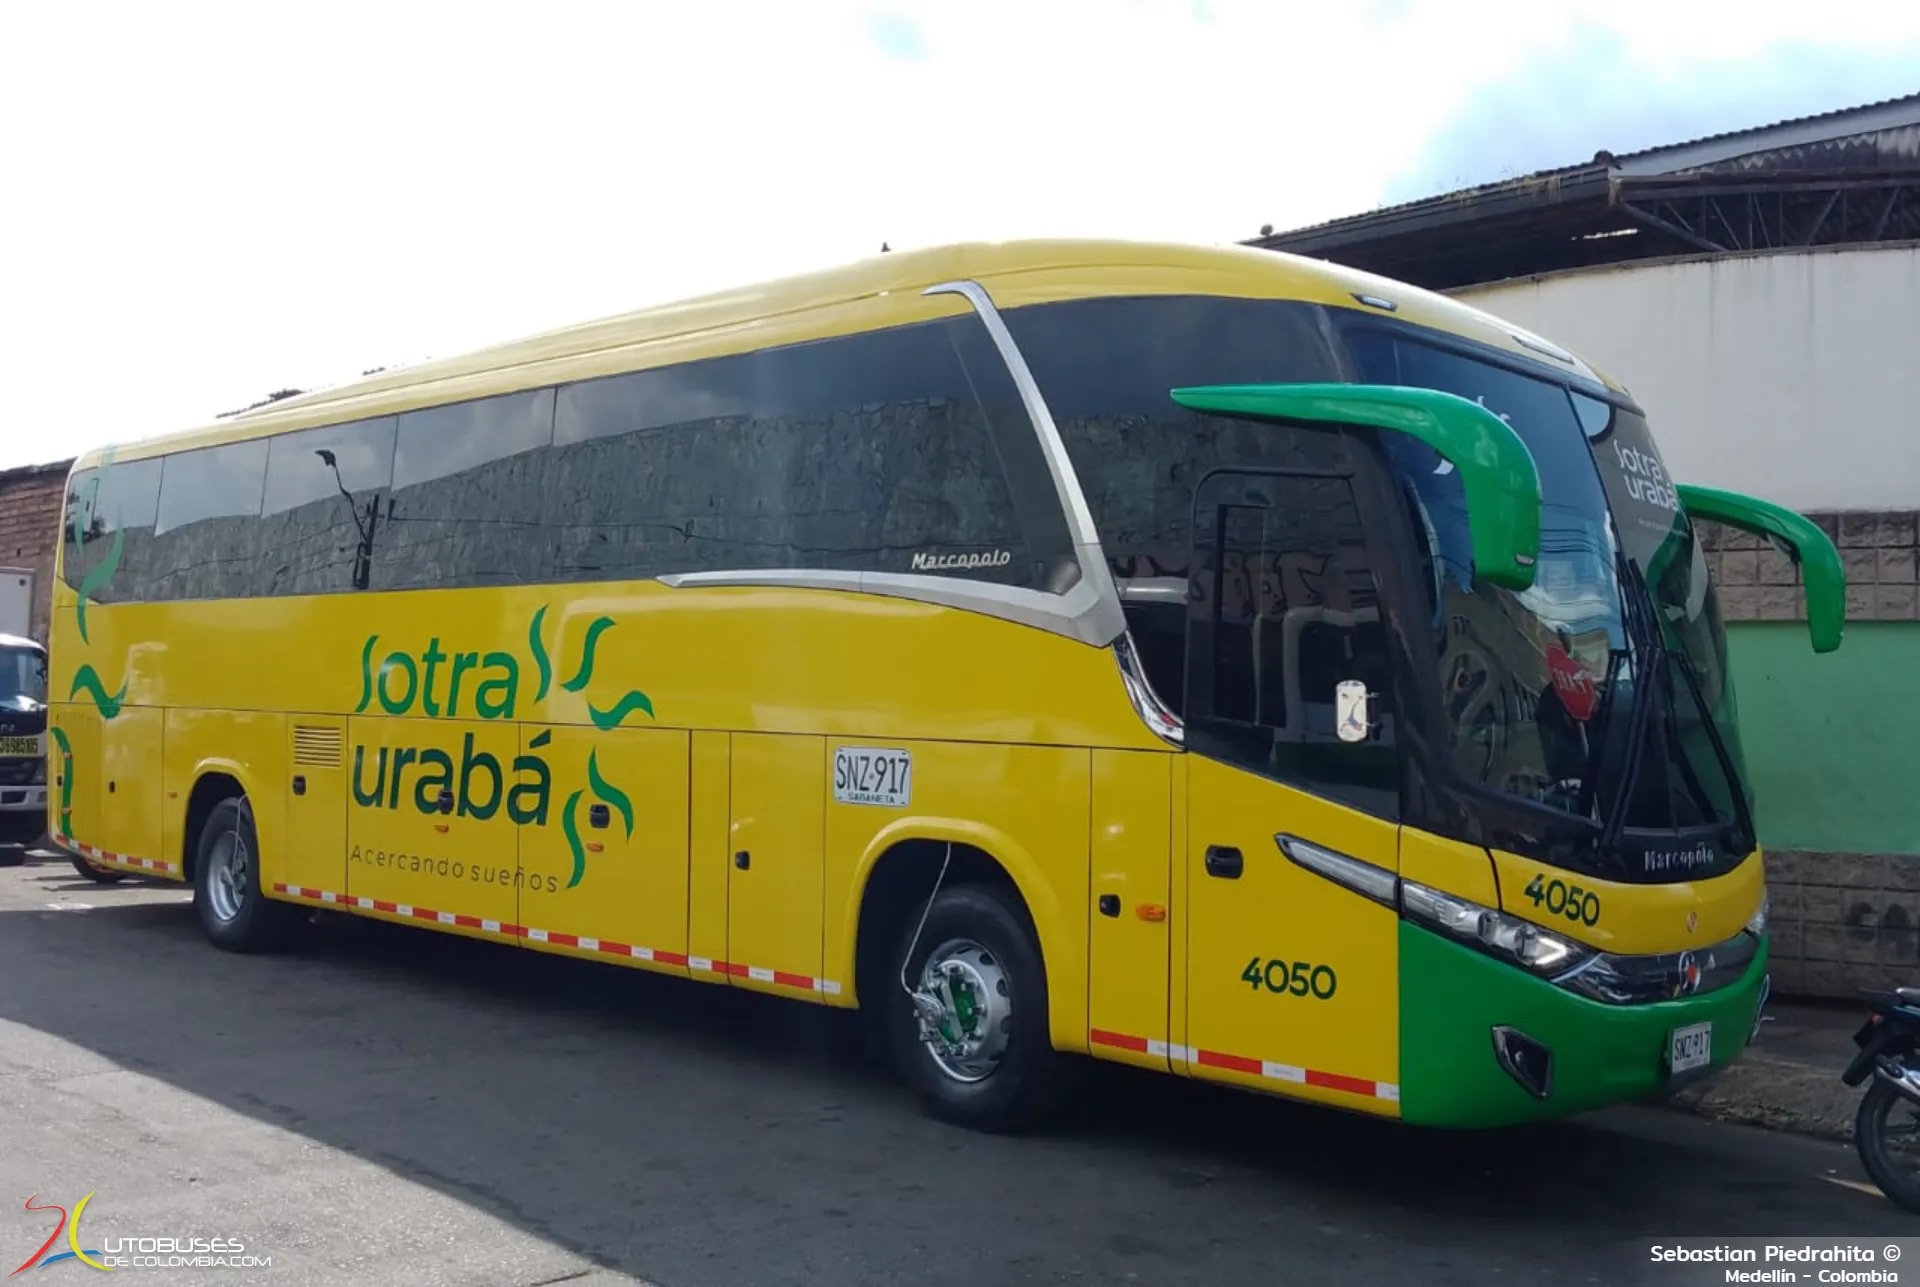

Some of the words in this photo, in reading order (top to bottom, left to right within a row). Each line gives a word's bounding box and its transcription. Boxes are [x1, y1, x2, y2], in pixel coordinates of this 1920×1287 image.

[911, 547, 1011, 570] Marcopolo
[355, 634, 519, 719] Sotra
[352, 728, 552, 827] urabá
[350, 844, 464, 879] Acercando
[471, 863, 559, 894] sueños
[1525, 873, 1600, 926] 4050
[1241, 956, 1337, 1001] 4050
